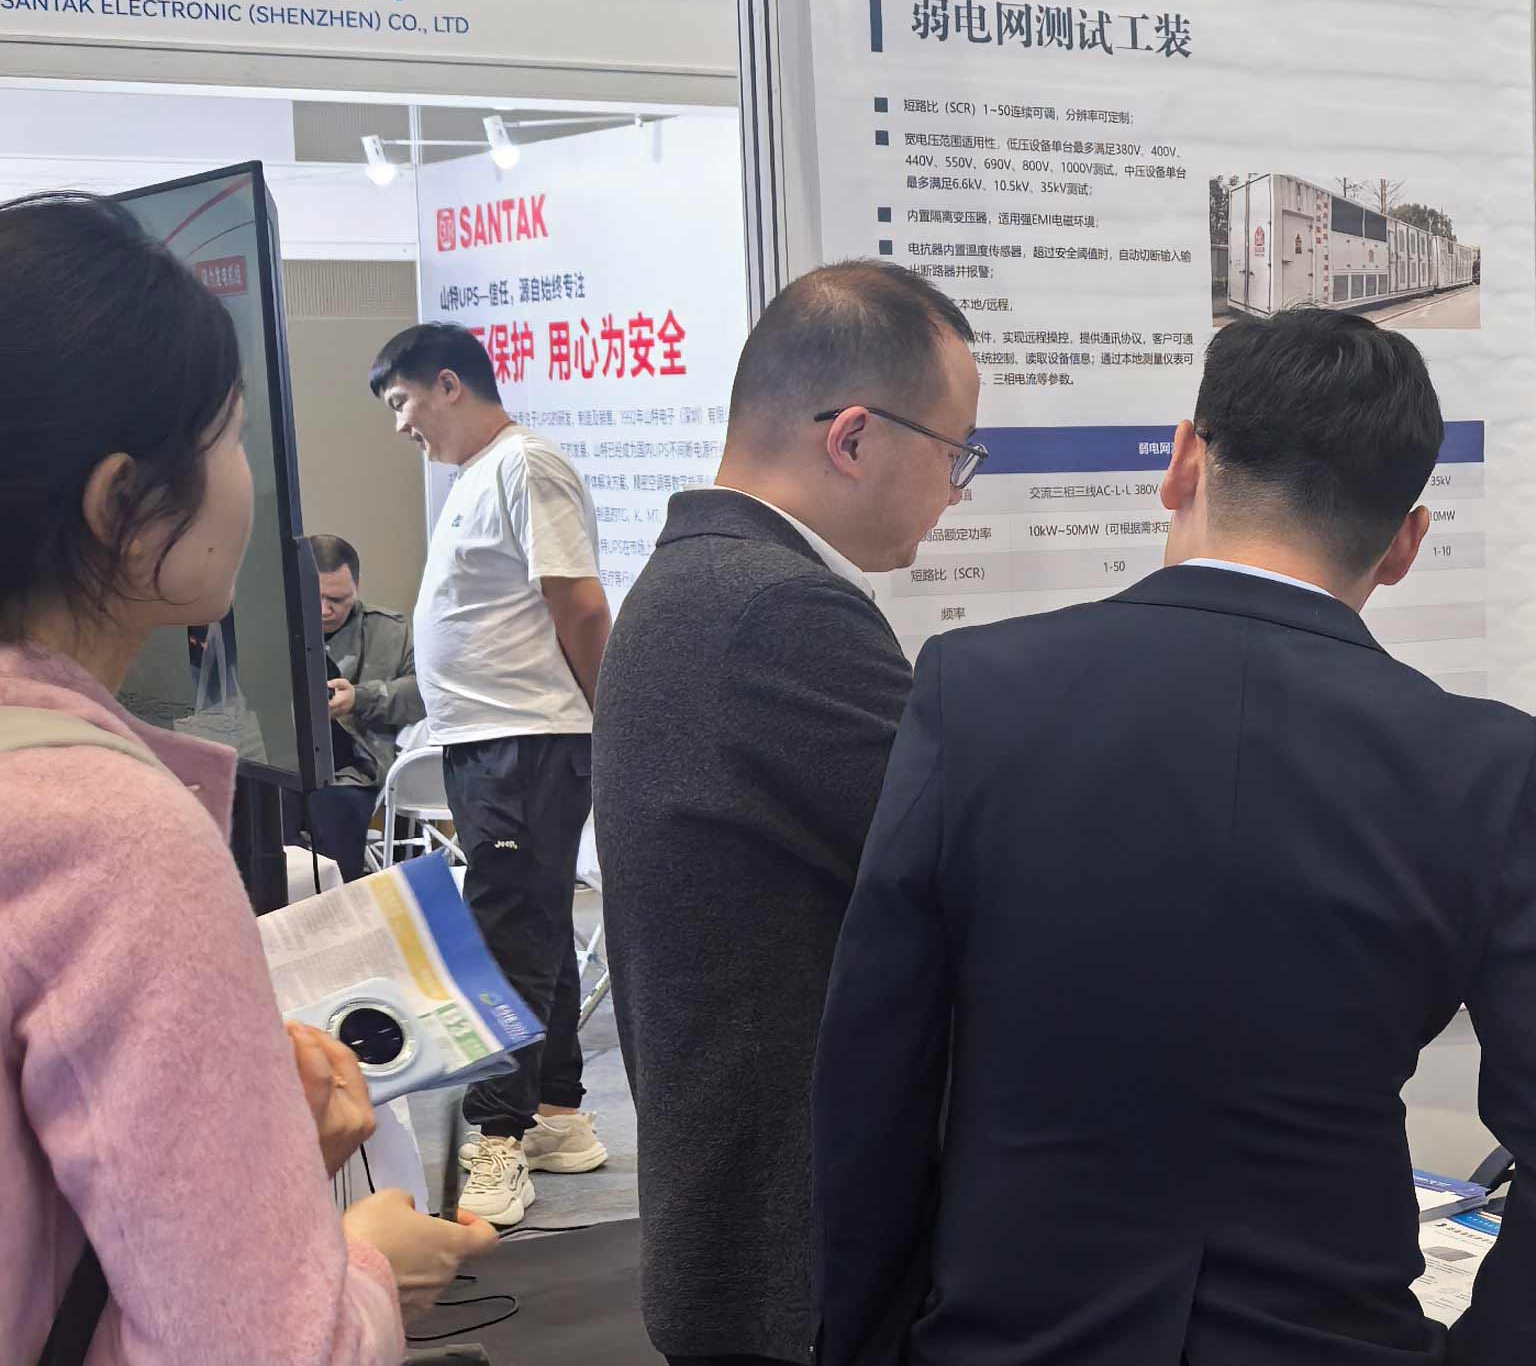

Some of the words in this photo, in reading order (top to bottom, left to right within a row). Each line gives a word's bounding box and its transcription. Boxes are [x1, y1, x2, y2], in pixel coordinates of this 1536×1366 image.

[248, 3, 382, 33] (SHENZHEN)
[388, 11, 428, 36] CO.,
[433, 15, 470, 35] LTD
[459, 193, 548, 250] SANTAK
[466, 320, 535, 384] 保护
[548, 308, 686, 381] 用心为安全
[978, 372, 1075, 387] 、三相电流等参数。
[1103, 561, 1126, 573] 1-50
[941, 606, 966, 621] 频率
